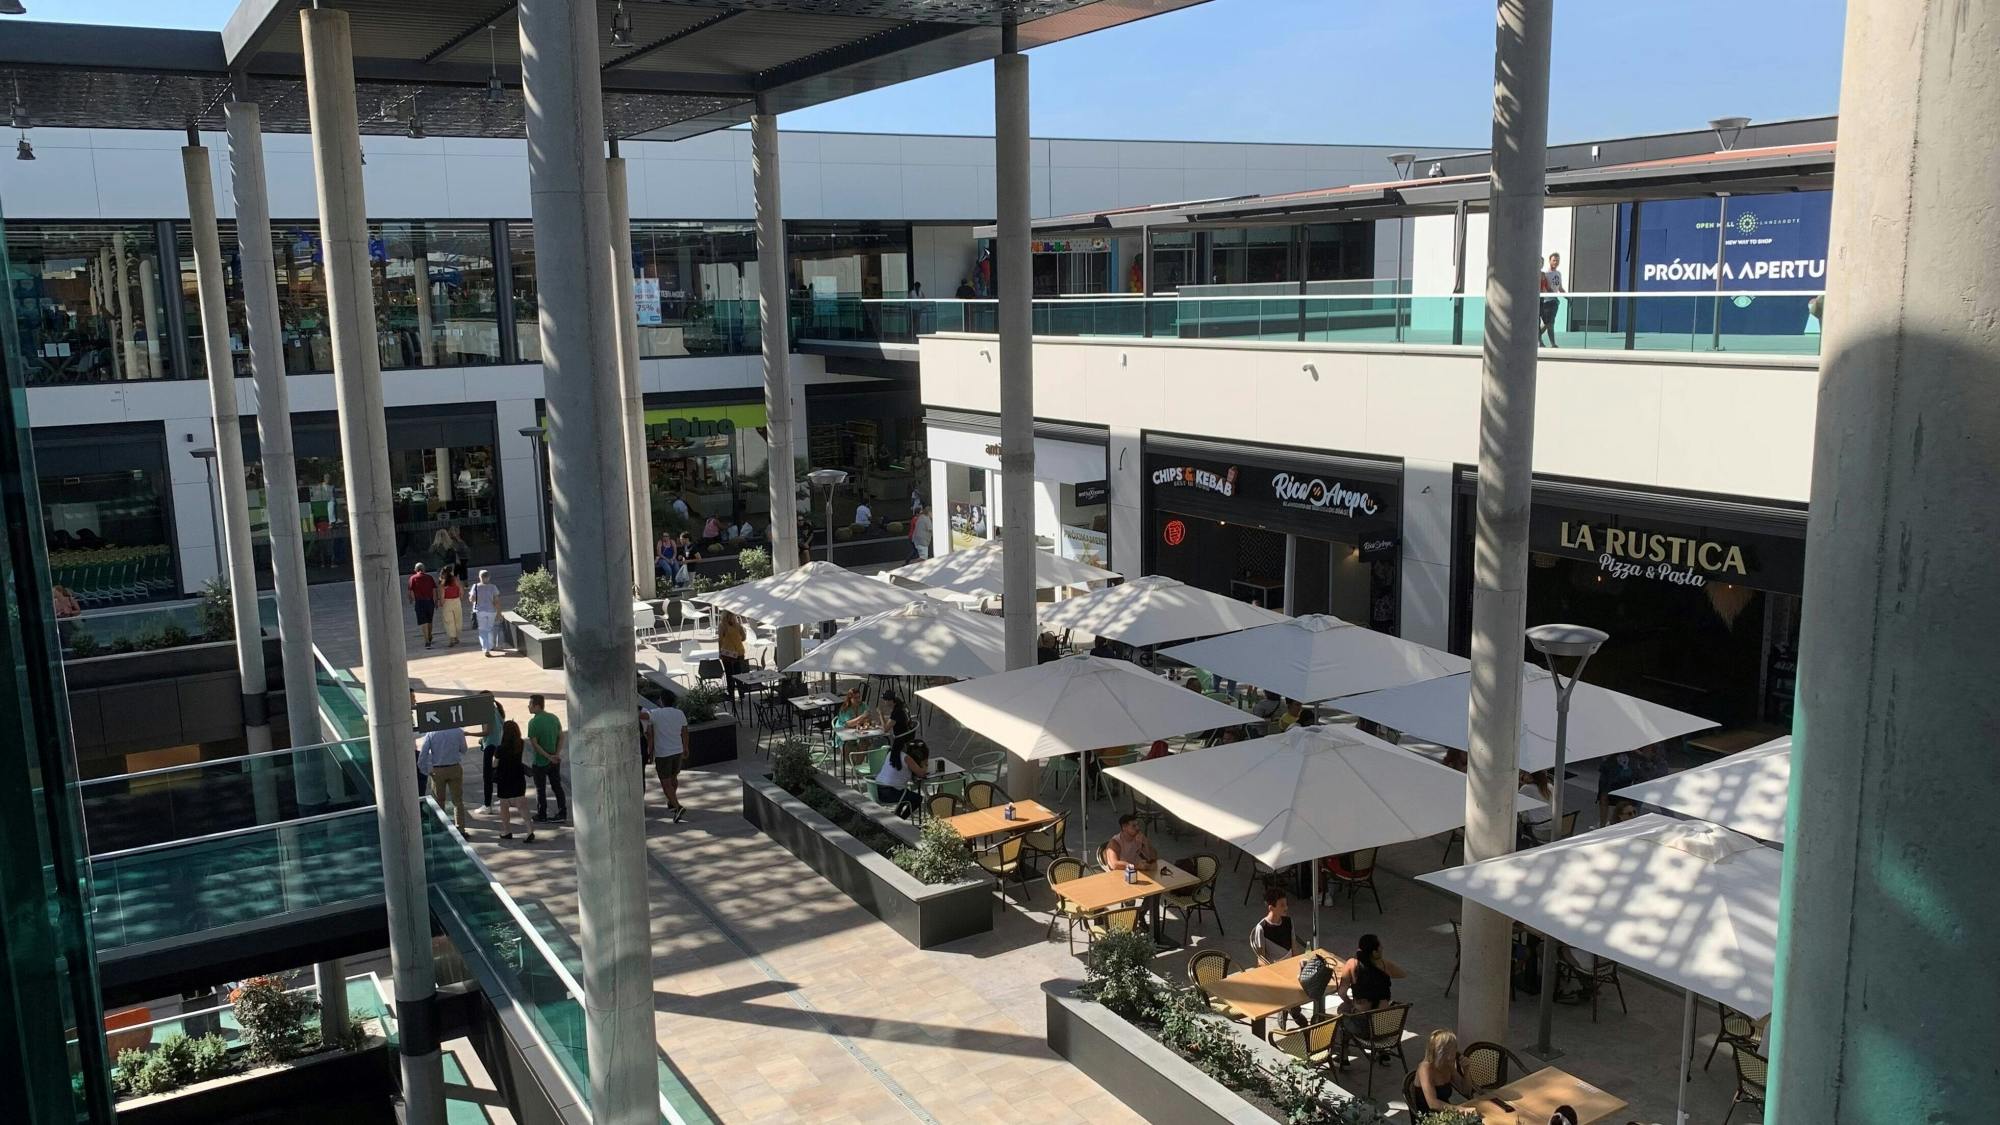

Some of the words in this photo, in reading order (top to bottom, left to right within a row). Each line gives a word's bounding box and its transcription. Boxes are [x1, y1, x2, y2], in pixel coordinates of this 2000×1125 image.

[1644, 258, 1734, 281] PRÓXIMA
[1738, 259, 1825, 280] APERTU
[1152, 467, 1183, 485] CHIPS
[1195, 469, 1232, 497] KEBAB
[1560, 521, 1595, 552] LA
[1606, 528, 1747, 576] RUSTICA
[1599, 553, 1643, 579] Pizza
[1645, 565, 1656, 579] &
[1657, 562, 1707, 587] Pasta
